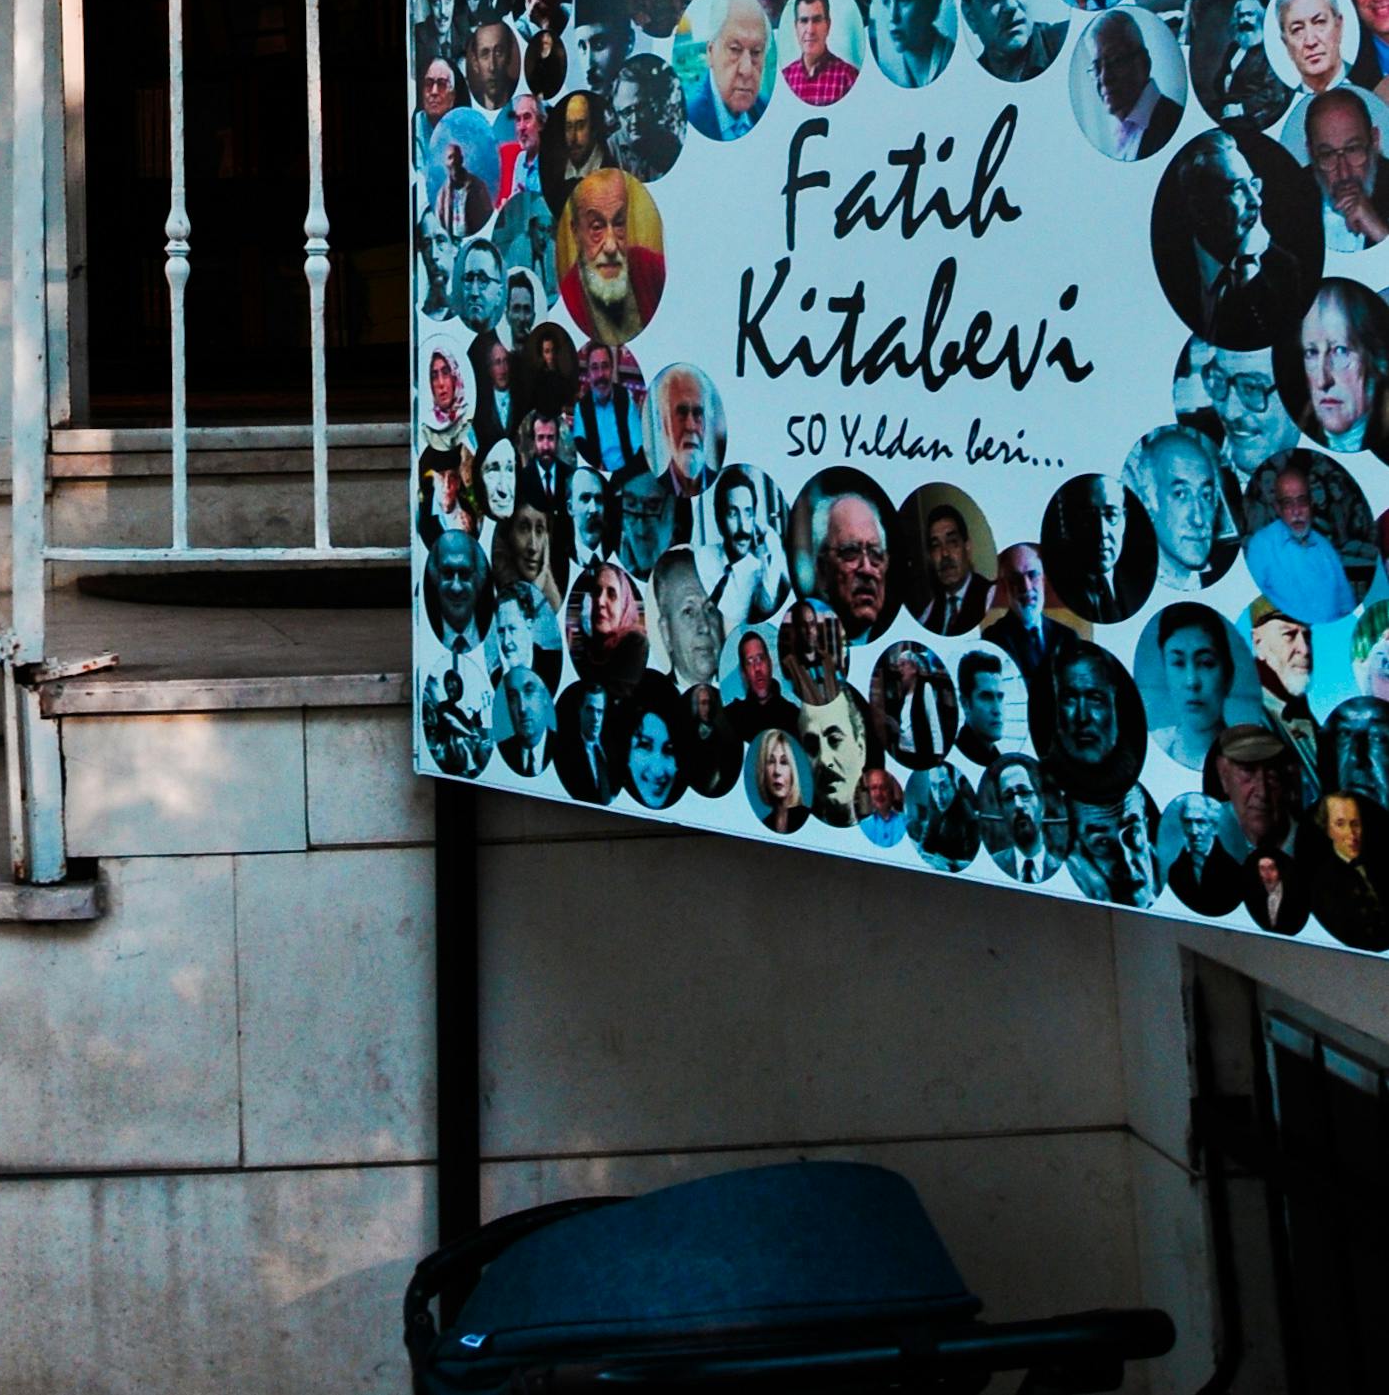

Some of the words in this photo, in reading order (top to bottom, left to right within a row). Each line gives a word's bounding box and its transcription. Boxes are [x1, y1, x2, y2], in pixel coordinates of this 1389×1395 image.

[781, 103, 1022, 251] Fatih
[736, 257, 1094, 393] Kitabevi
[786, 413, 827, 457] 50
[965, 417, 1065, 468] beri...
